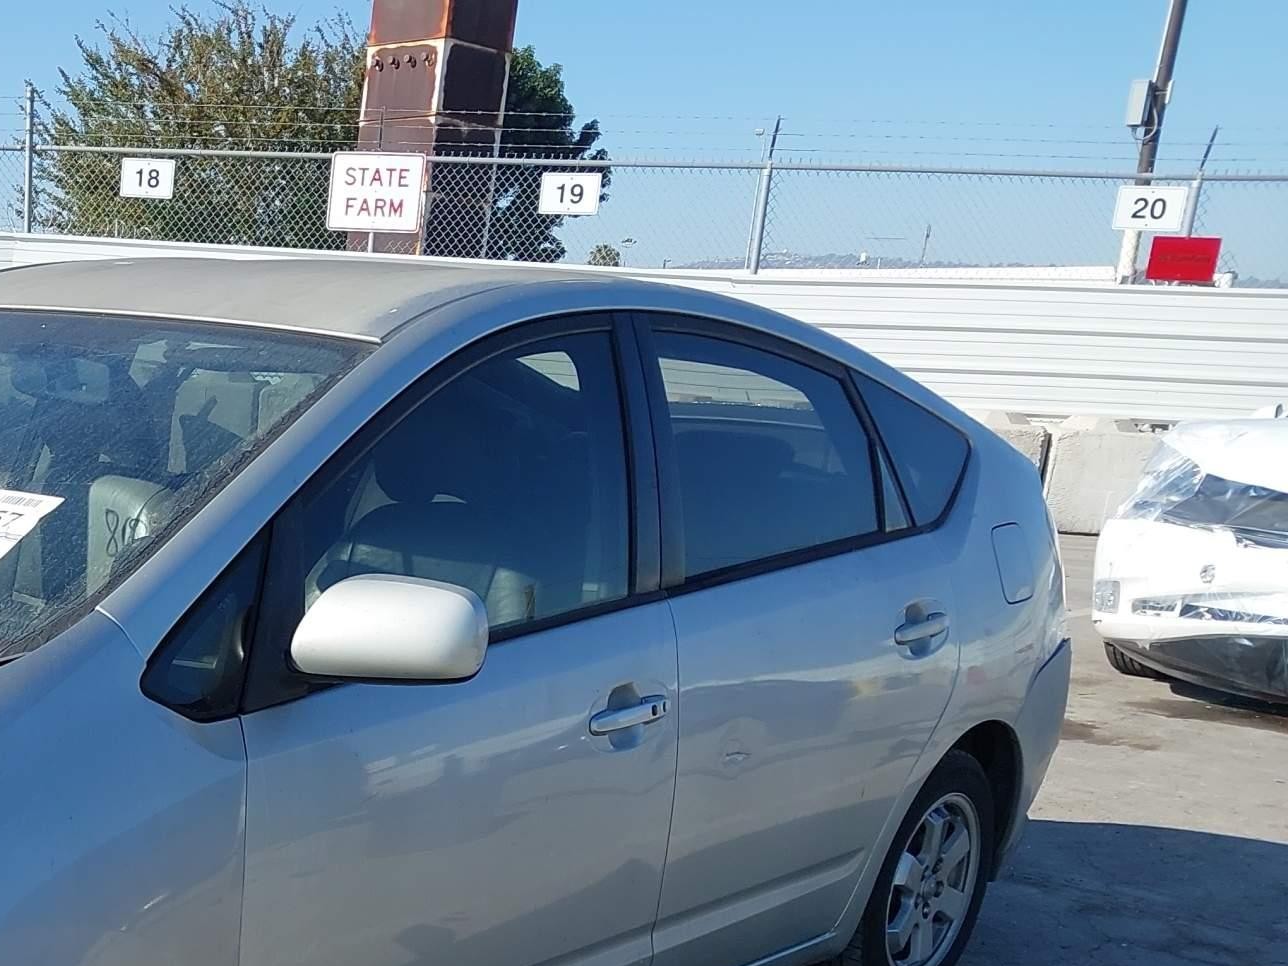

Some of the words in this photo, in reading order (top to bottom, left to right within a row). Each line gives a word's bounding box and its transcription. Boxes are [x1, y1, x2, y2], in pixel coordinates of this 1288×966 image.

[135, 168, 160, 189] 18
[344, 166, 410, 188] STATE
[556, 183, 584, 204] 19
[344, 197, 403, 218] FARM
[1131, 197, 1167, 220] 20
